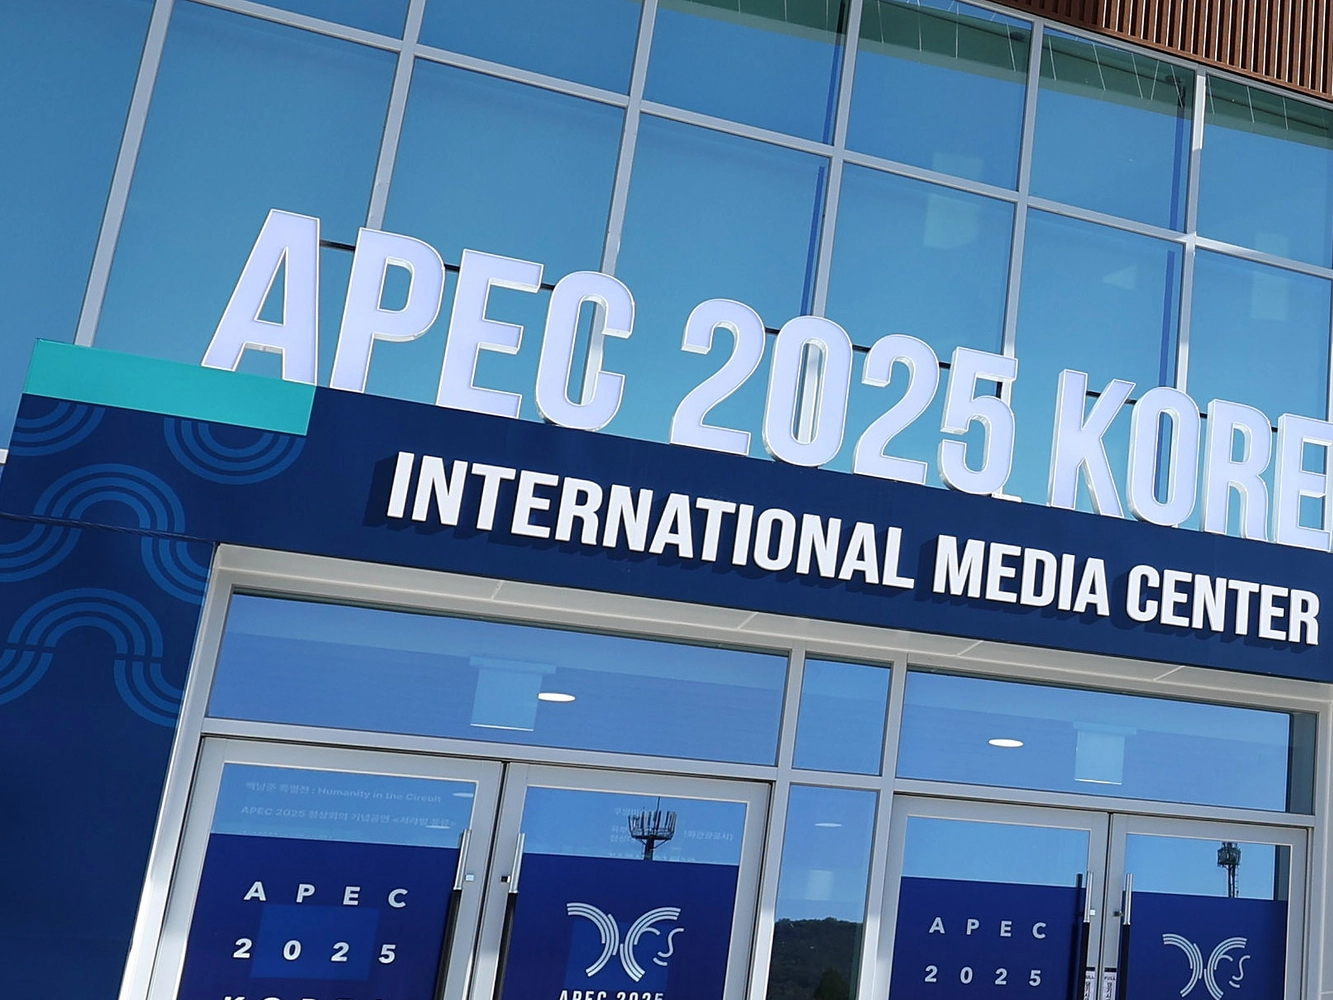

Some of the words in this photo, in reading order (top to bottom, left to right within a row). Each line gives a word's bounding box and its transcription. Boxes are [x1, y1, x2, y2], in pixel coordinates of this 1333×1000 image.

[201, 209, 637, 432] APEC
[669, 297, 1019, 496] 2025
[386, 451, 914, 590] INTERNATIONAL
[932, 533, 1111, 617] MEDIA
[1126, 563, 1321, 647] CENTER
[317, 787, 370, 799] Humanity
[373, 789, 383, 798] in
[386, 791, 403, 801] the
[405, 793, 441, 804] Circuit
[241, 805, 273, 816] APEC
[275, 808, 306, 818] 2025
[243, 881, 408, 908] APEC
[929, 916, 1047, 939] APEC
[233, 937, 397, 964] 2025
[924, 965, 1042, 987] 2025
